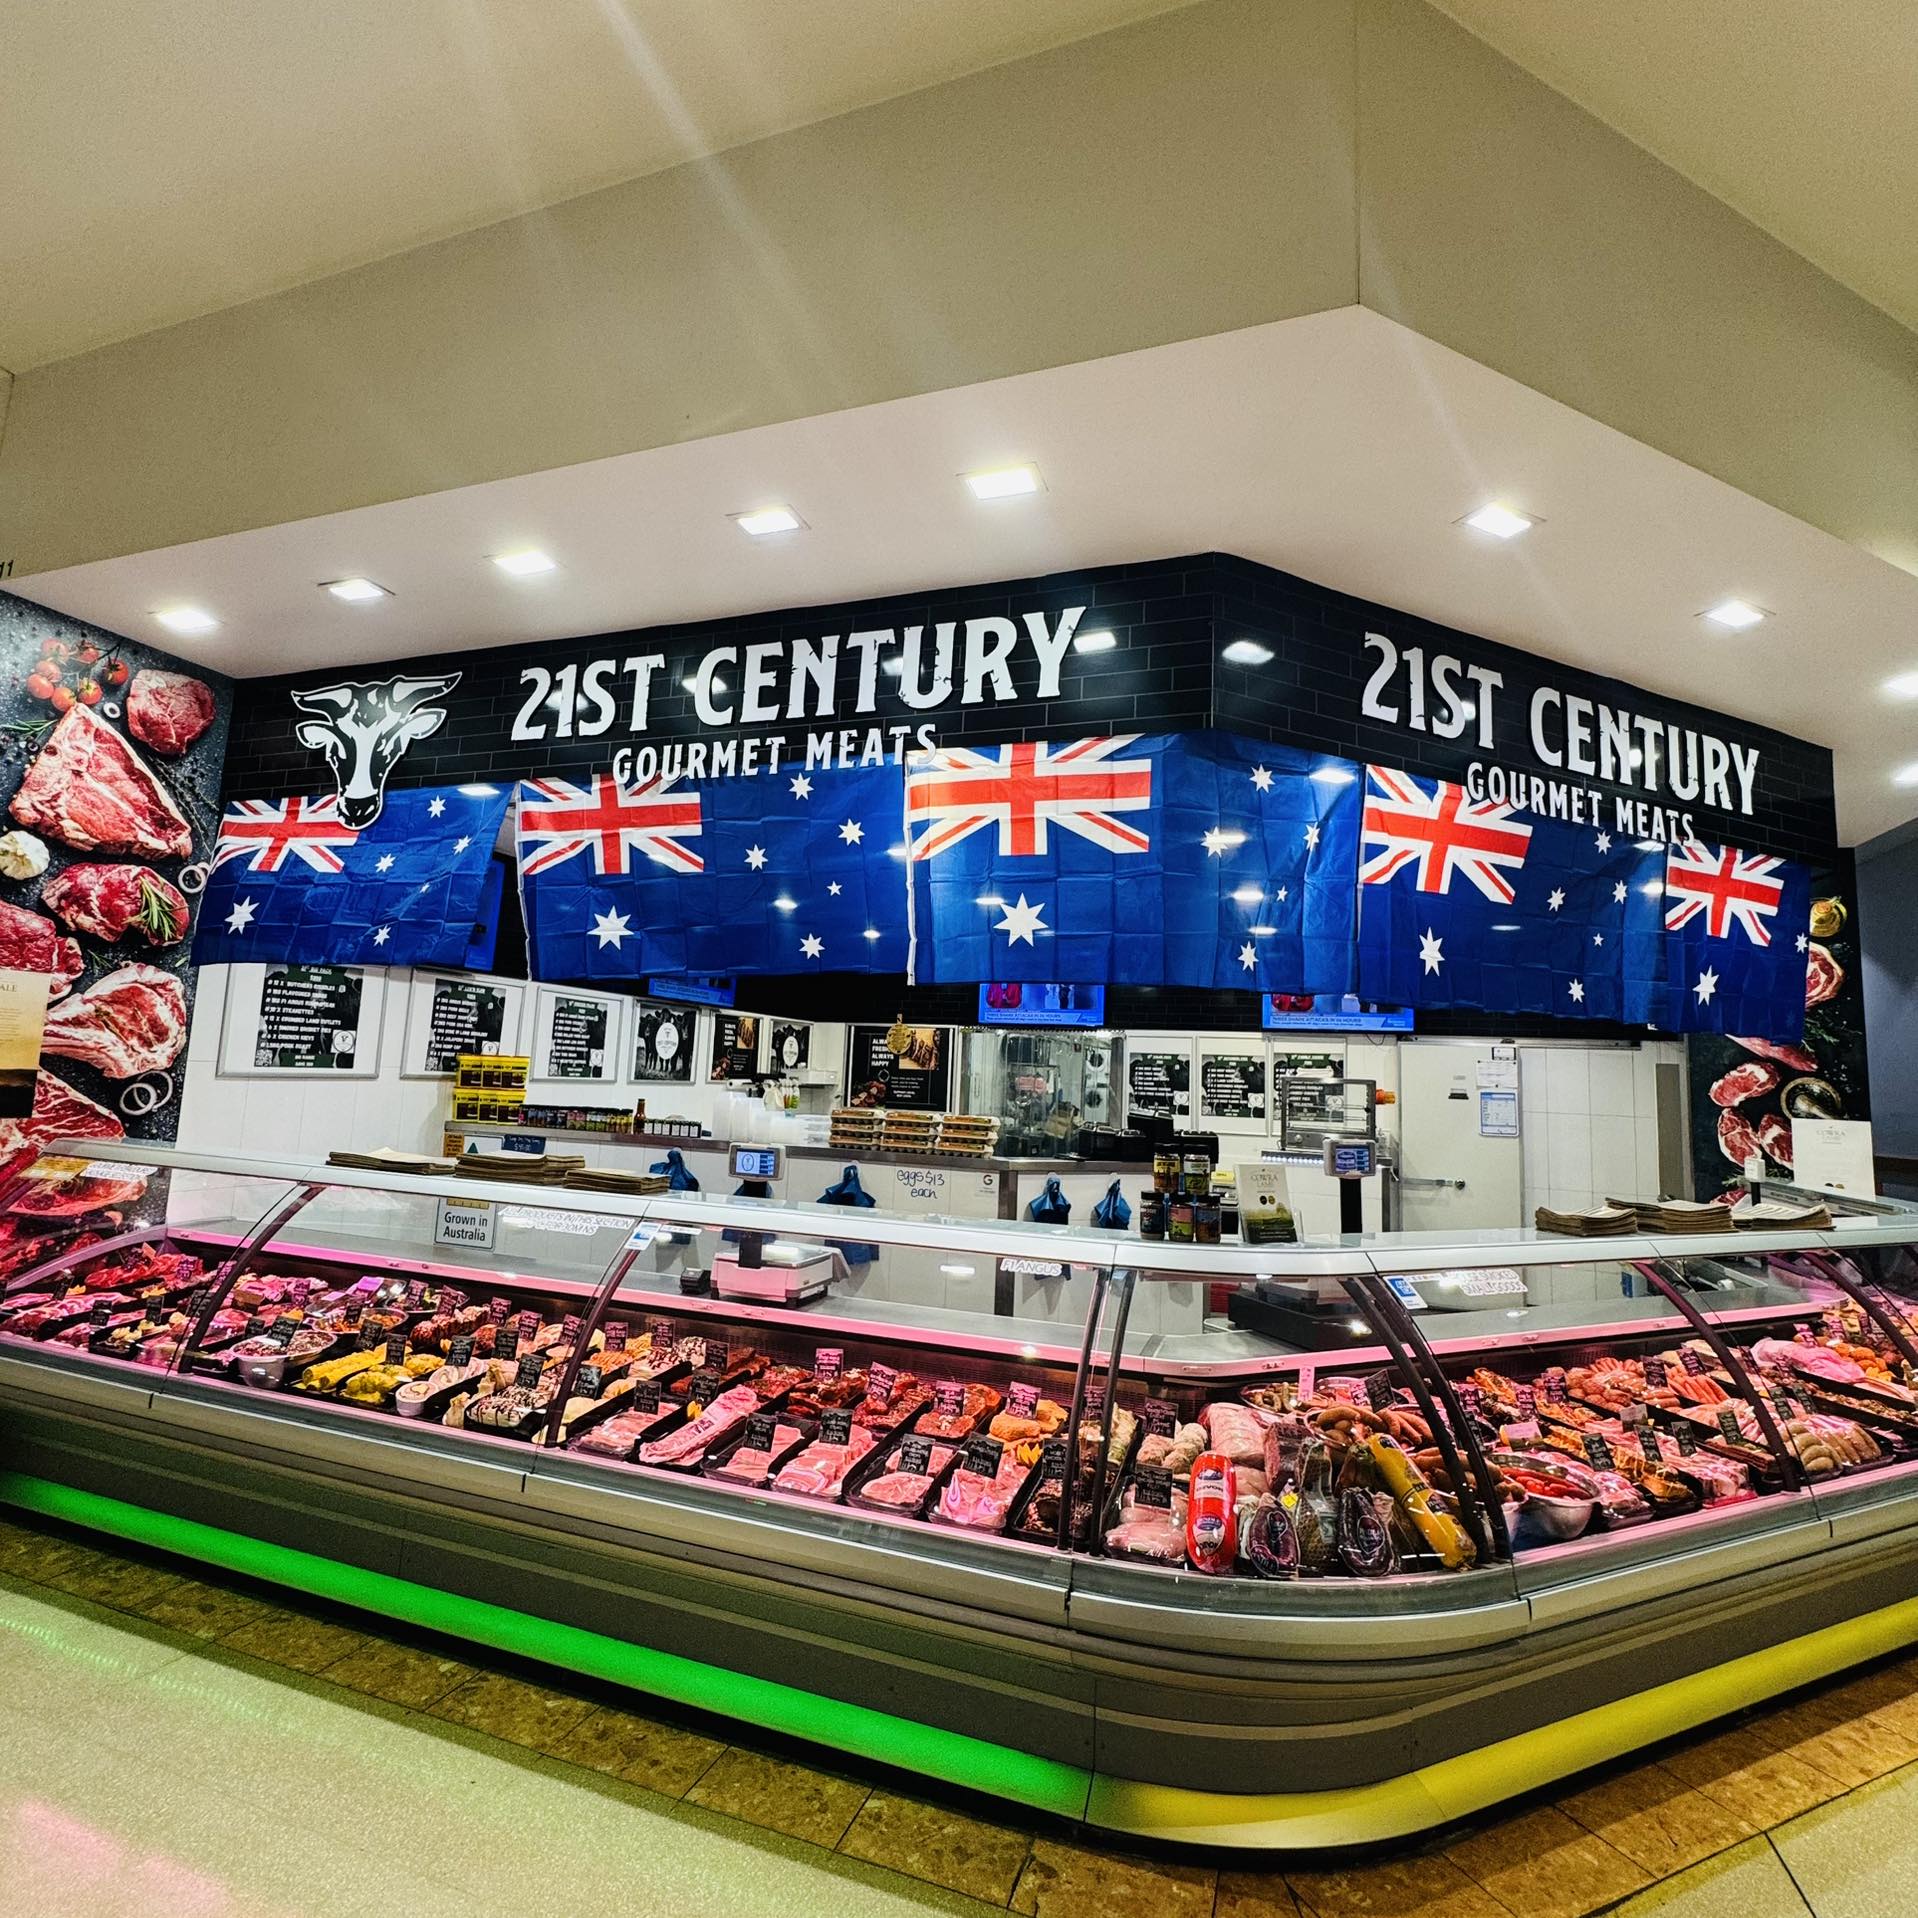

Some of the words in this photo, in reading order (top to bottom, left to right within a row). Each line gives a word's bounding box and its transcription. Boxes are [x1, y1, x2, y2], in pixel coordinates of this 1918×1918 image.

[511, 653, 665, 742] 21ST
[695, 606, 1086, 734] CENTURY
[1361, 632, 1503, 751] 21ST
[1530, 686, 1760, 816] CENTURY
[613, 736, 785, 784] GOURMET
[804, 724, 936, 771] MEATS
[1467, 762, 1602, 829] GOURMET
[1615, 796, 1694, 847] MEATS
[896, 1169, 924, 1187] eggs
[925, 1170, 944, 1186] $13
[910, 1187, 938, 1199] each
[444, 1212, 476, 1226] Grown
[479, 1214, 488, 1227] in
[443, 1226, 486, 1241] Australia
[1016, 1261, 1060, 1274] ANGUS
